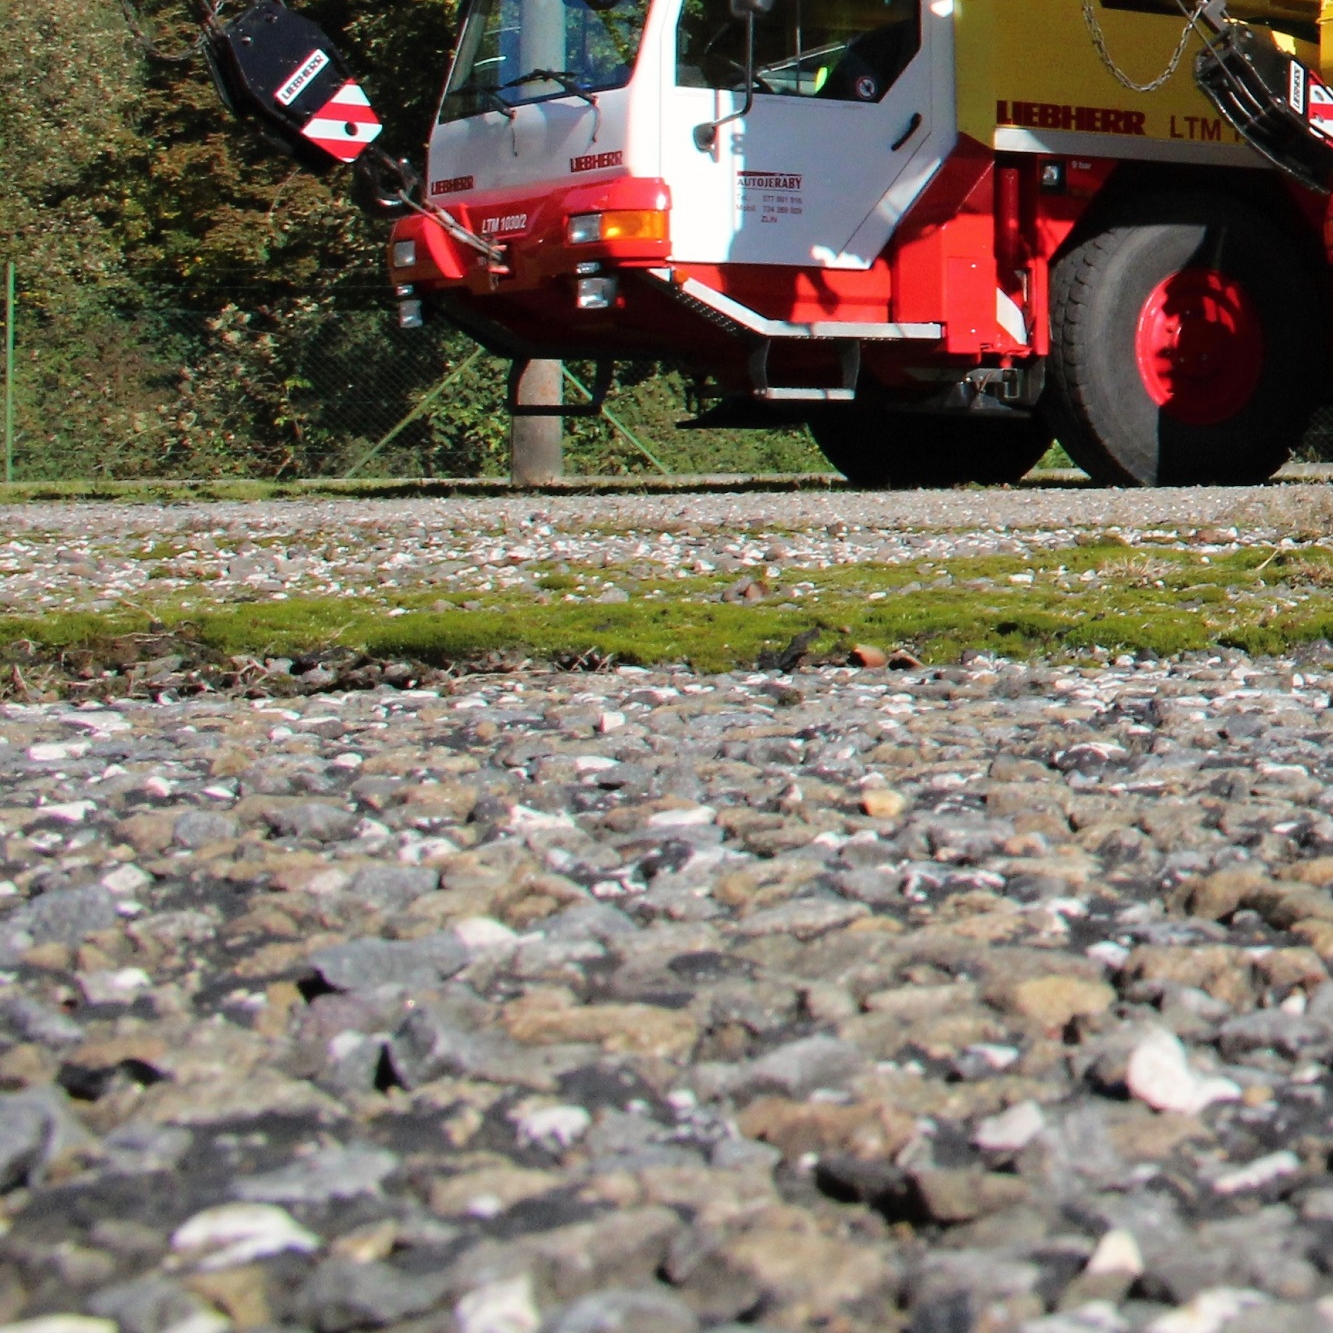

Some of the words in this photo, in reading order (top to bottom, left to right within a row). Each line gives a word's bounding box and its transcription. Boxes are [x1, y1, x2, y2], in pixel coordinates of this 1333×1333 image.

[281, 54, 325, 100] LIEBHERR
[996, 100, 1146, 136] LIEBHERR
[1169, 114, 1221, 141] LTM
[570, 150, 623, 173] LIEBHERR
[431, 175, 474, 195] LIEBHERR
[737, 177, 802, 189] AUTOJERABY
[481, 218, 500, 234] LTM
